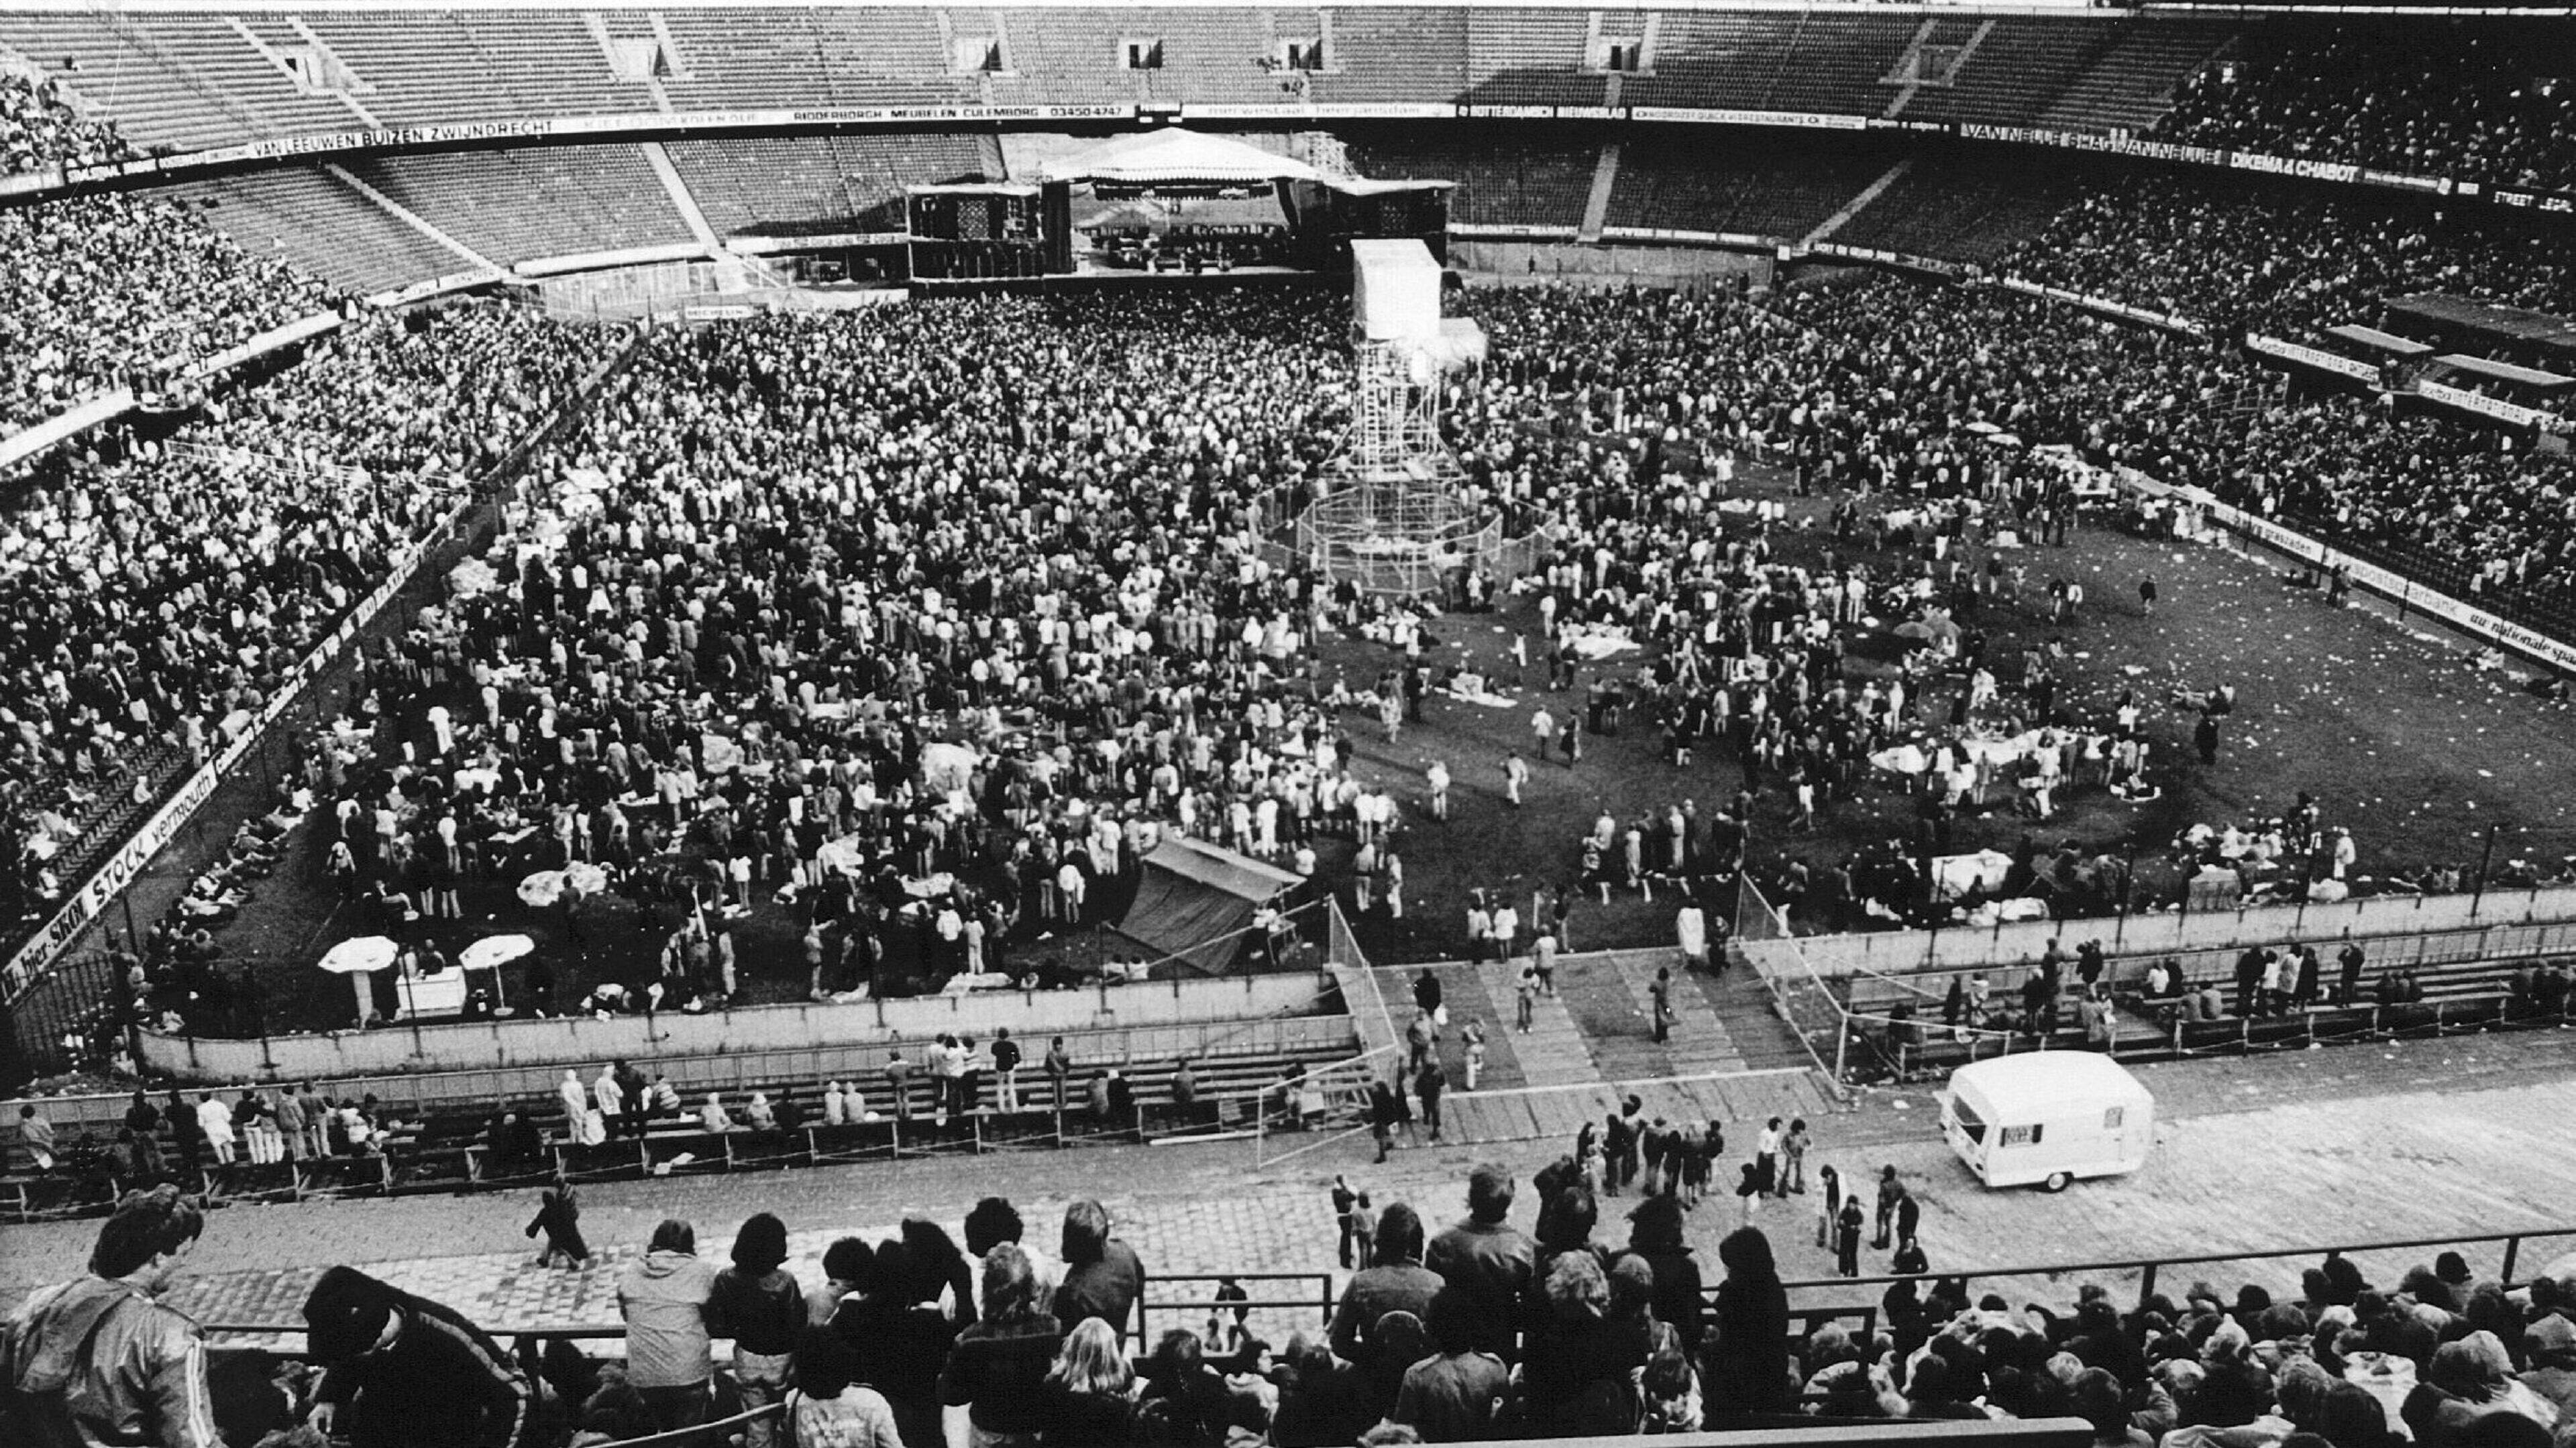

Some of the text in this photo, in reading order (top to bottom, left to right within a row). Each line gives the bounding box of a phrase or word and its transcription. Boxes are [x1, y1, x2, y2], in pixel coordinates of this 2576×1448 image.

[890, 109, 957, 118] MEUBELEN
[963, 107, 1040, 118] CULEMBORG
[254, 142, 282, 157] VAN
[284, 133, 356, 154] LEEUWEN
[362, 127, 423, 146] BUIZEN
[431, 121, 551, 140] ZWIJNDRECHT
[2295, 160, 2360, 183] CHABOT
[2491, 622, 2551, 651] nationale
[93, 772, 212, 905] STOCK vermouth
